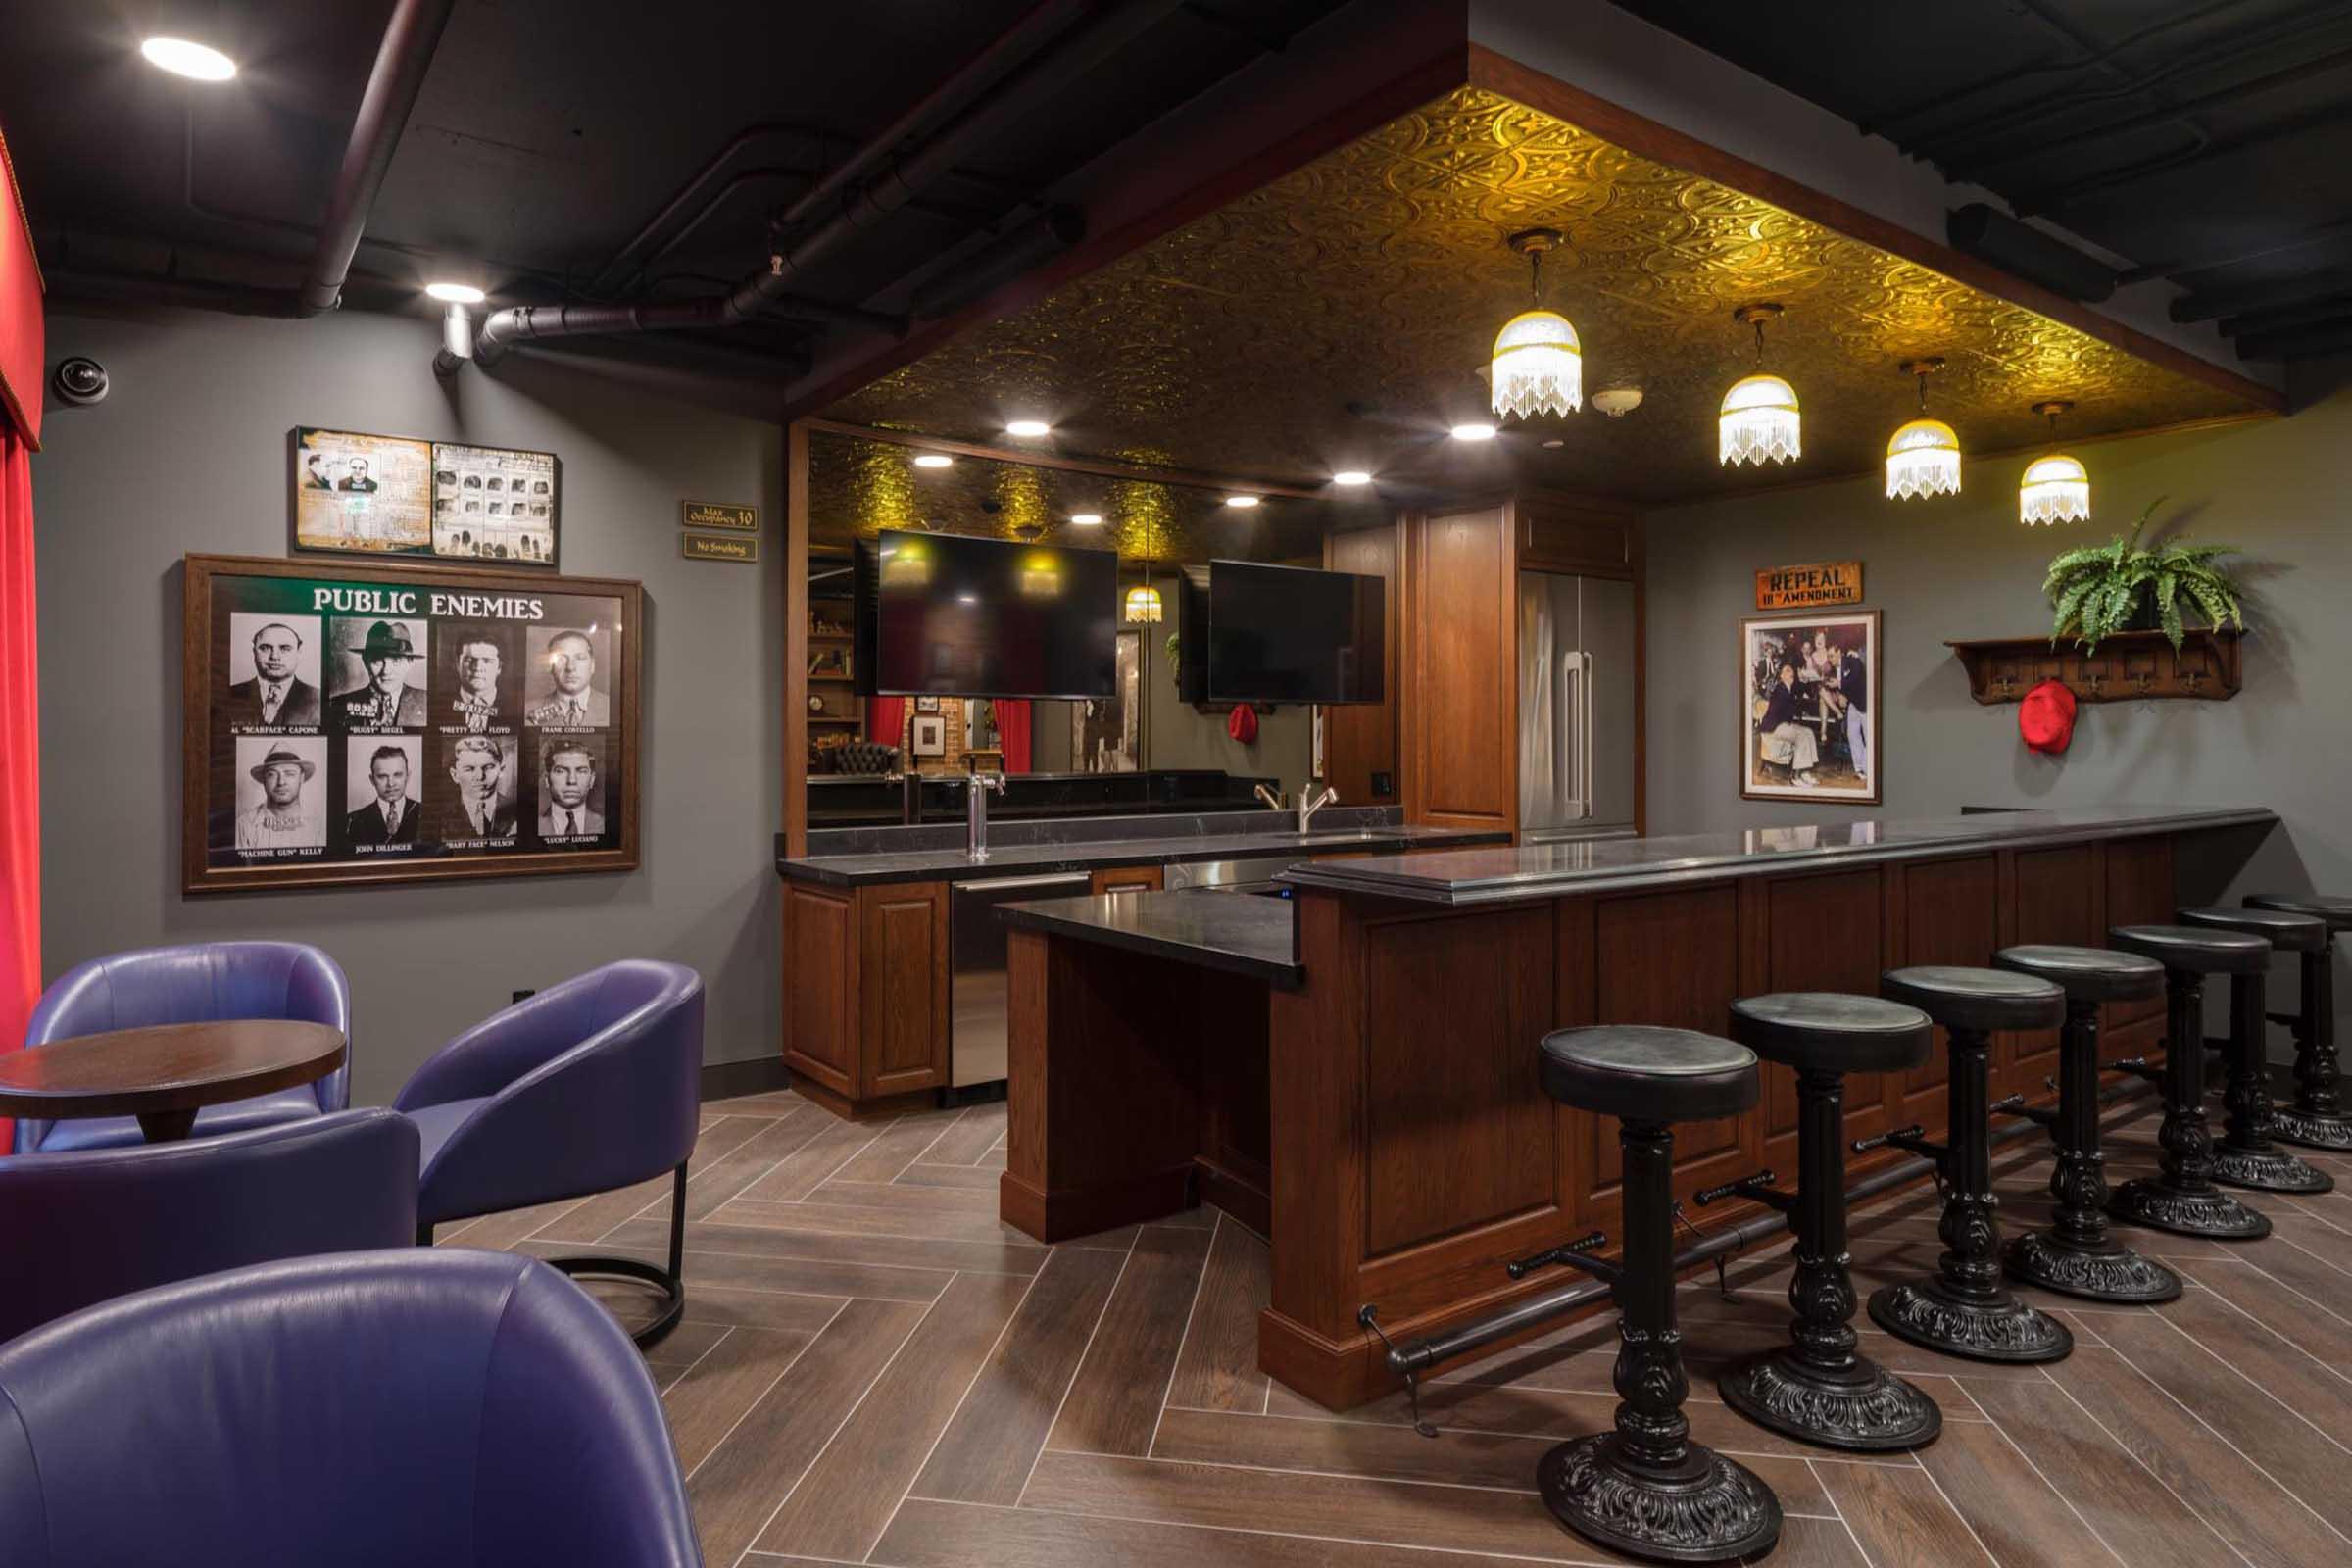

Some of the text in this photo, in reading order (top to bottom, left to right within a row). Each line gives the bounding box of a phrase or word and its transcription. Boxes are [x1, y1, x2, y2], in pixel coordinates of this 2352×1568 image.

[690, 511, 736, 526] Occupancy
[697, 540, 746, 557] No Smoking
[1770, 569, 1846, 592] REPEAL
[313, 588, 544, 620] PUBLIC ENEMIES
[1784, 588, 1853, 604] AMENDMENT
[355, 844, 412, 854] JOHN DILLINGER
